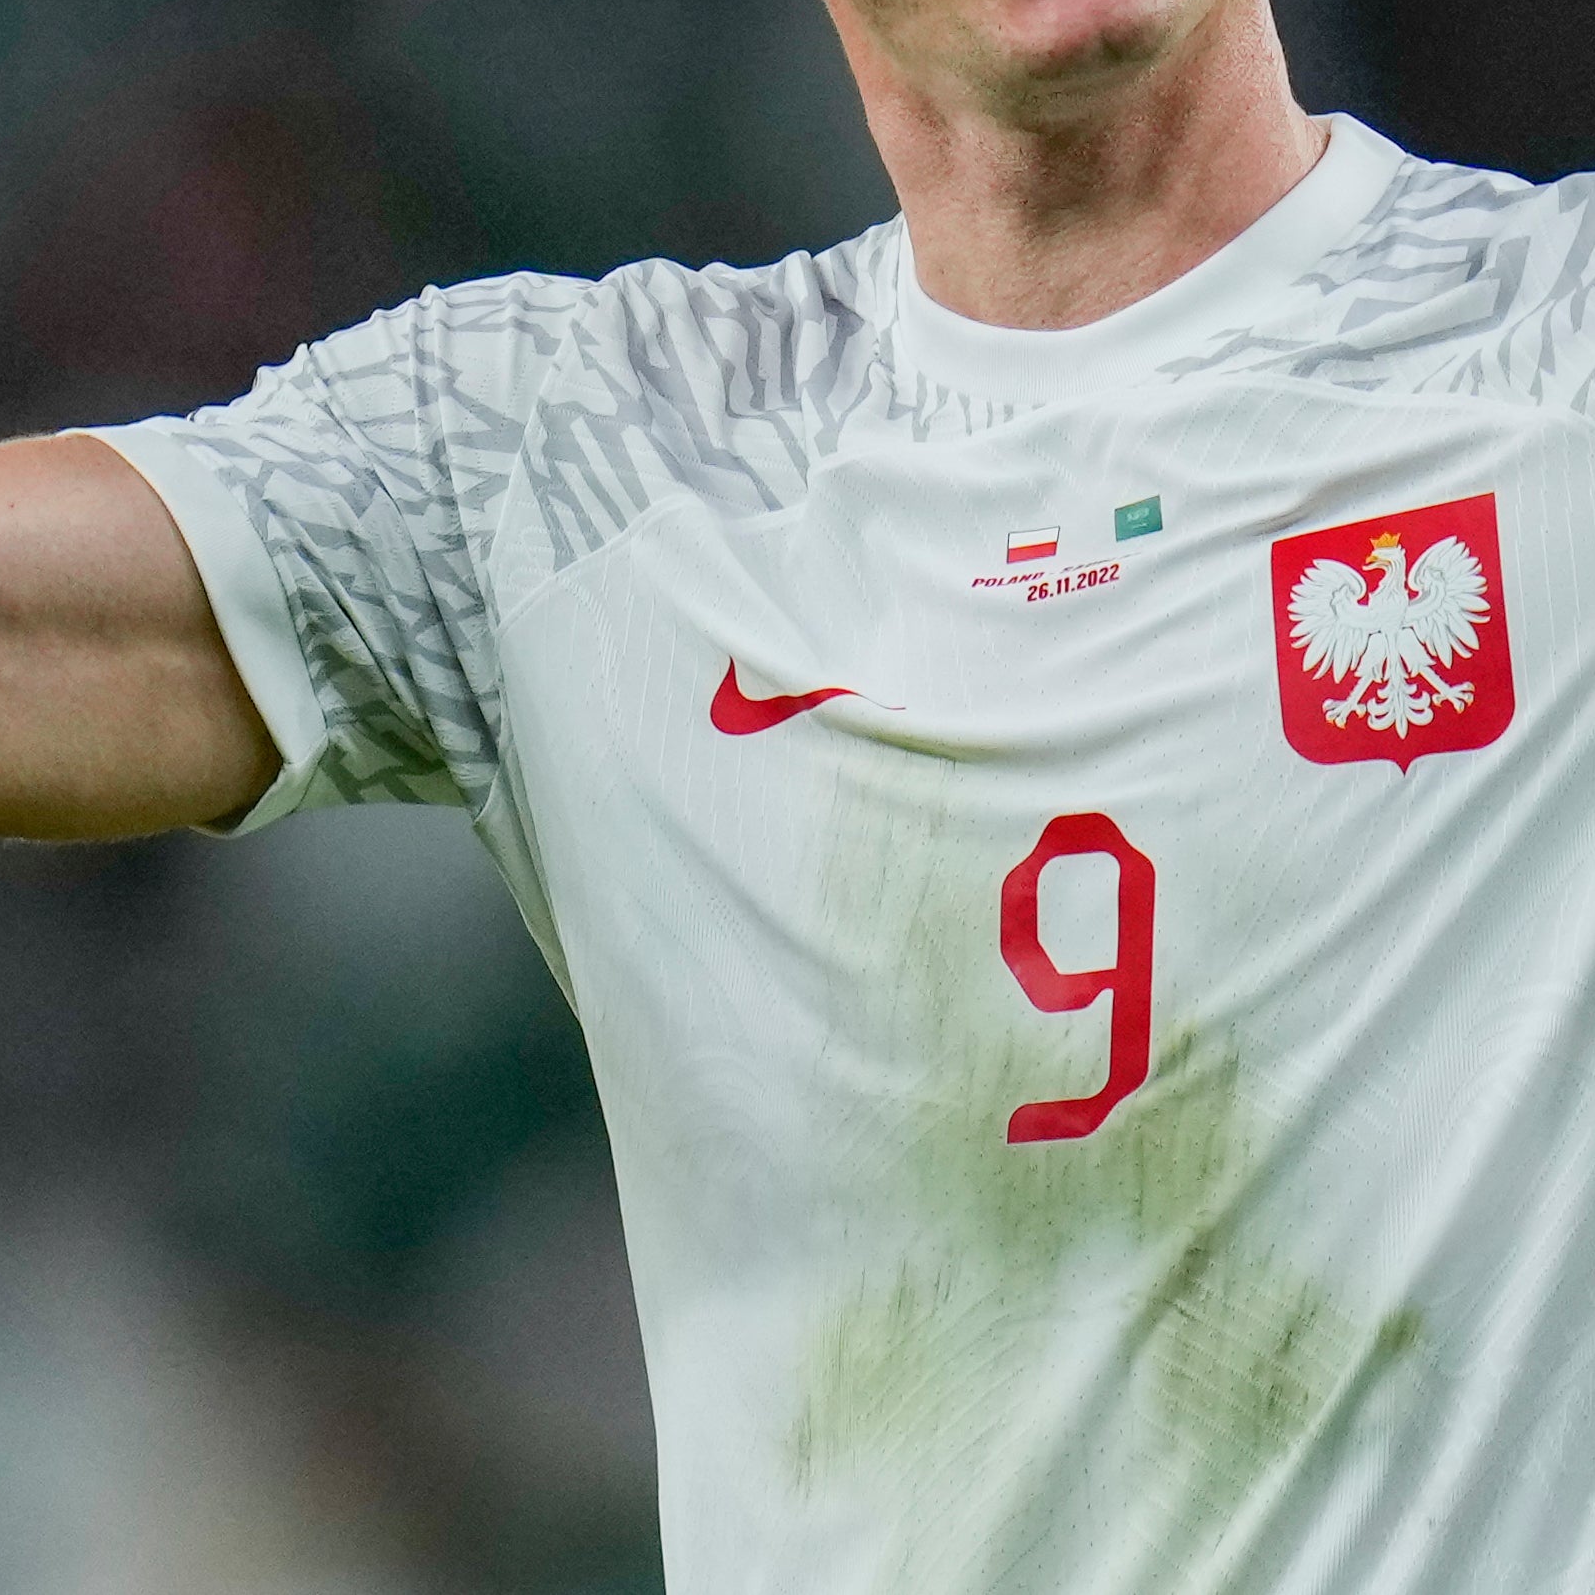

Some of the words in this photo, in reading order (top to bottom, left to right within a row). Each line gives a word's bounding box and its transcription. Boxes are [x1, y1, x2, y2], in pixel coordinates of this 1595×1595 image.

[971, 572, 1045, 587] POLAND
[1027, 563, 1120, 602] 26.11.2022
[1000, 812, 1156, 1144] 9
